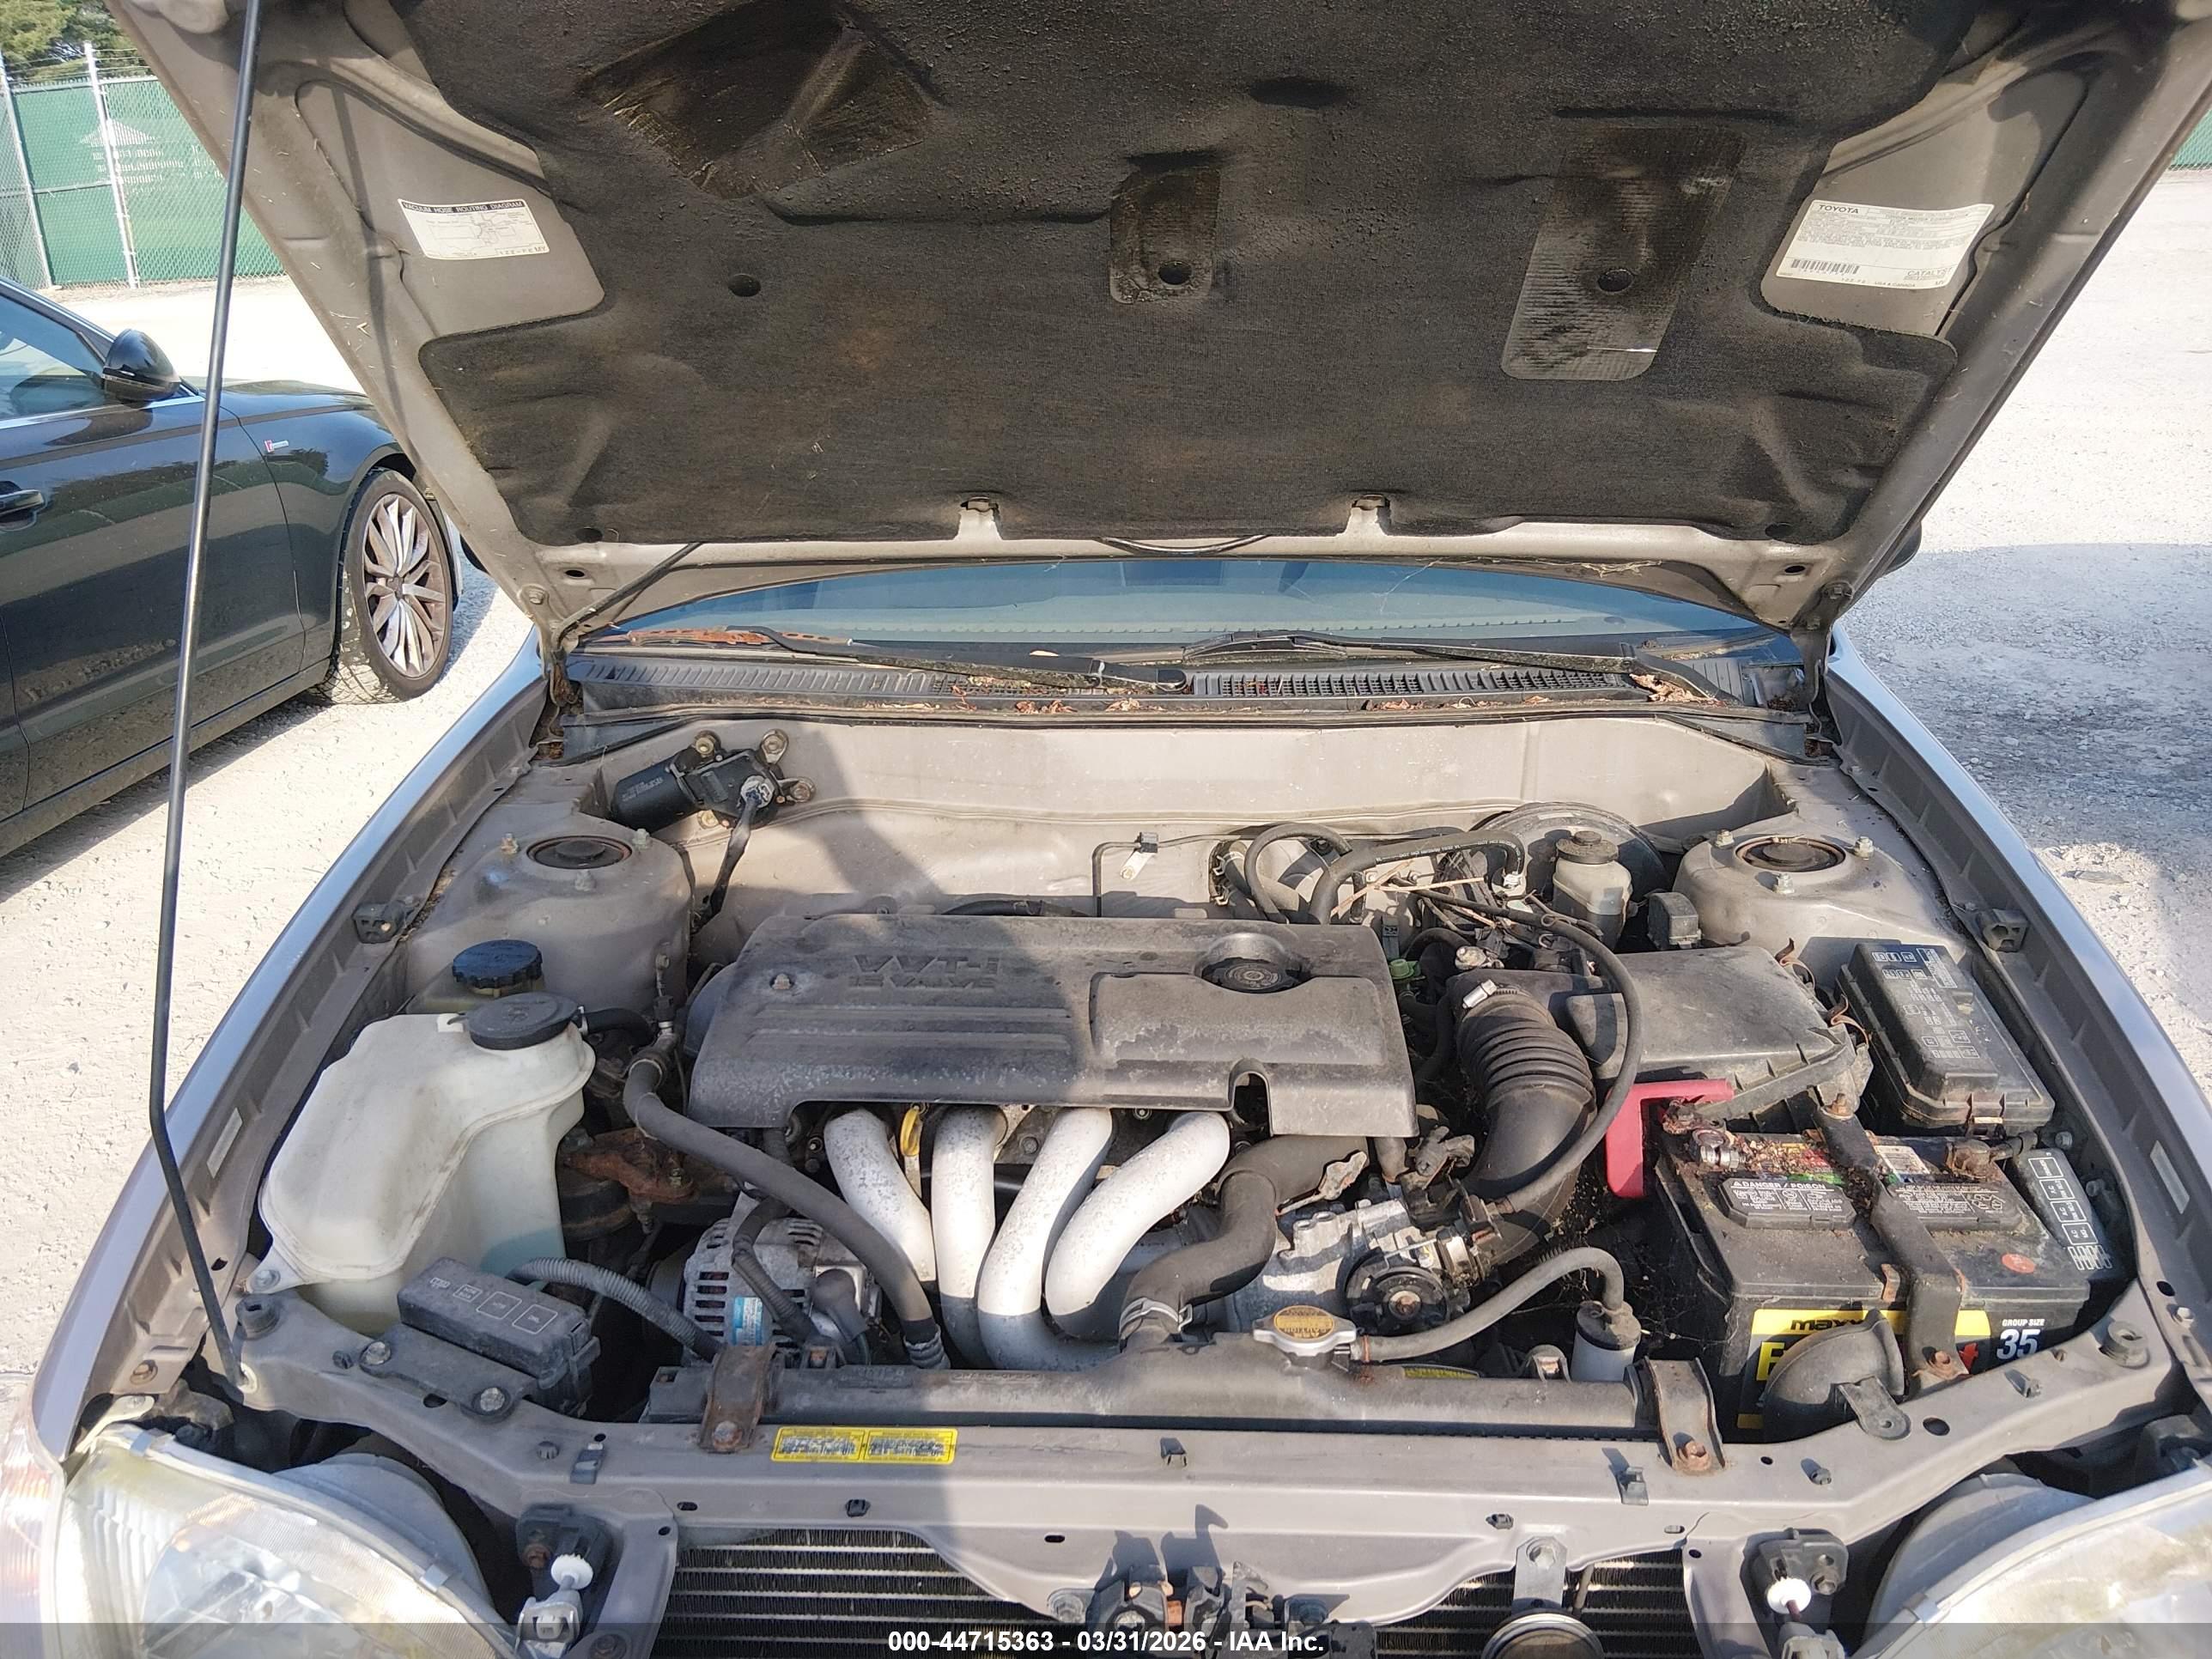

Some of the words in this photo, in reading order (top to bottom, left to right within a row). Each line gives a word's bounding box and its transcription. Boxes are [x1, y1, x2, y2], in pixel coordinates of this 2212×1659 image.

[403, 203, 432, 213] VACUUM
[455, 204, 488, 213] ROUTING
[490, 202, 523, 210] DIAGRAM
[1819, 204, 1859, 214] TOYOTA
[1907, 266, 1952, 276] CATALYST
[2002, 1318, 2028, 1327] GROUP
[2028, 1318, 2045, 1327] SIZE
[1996, 1328, 2041, 1359] 35
